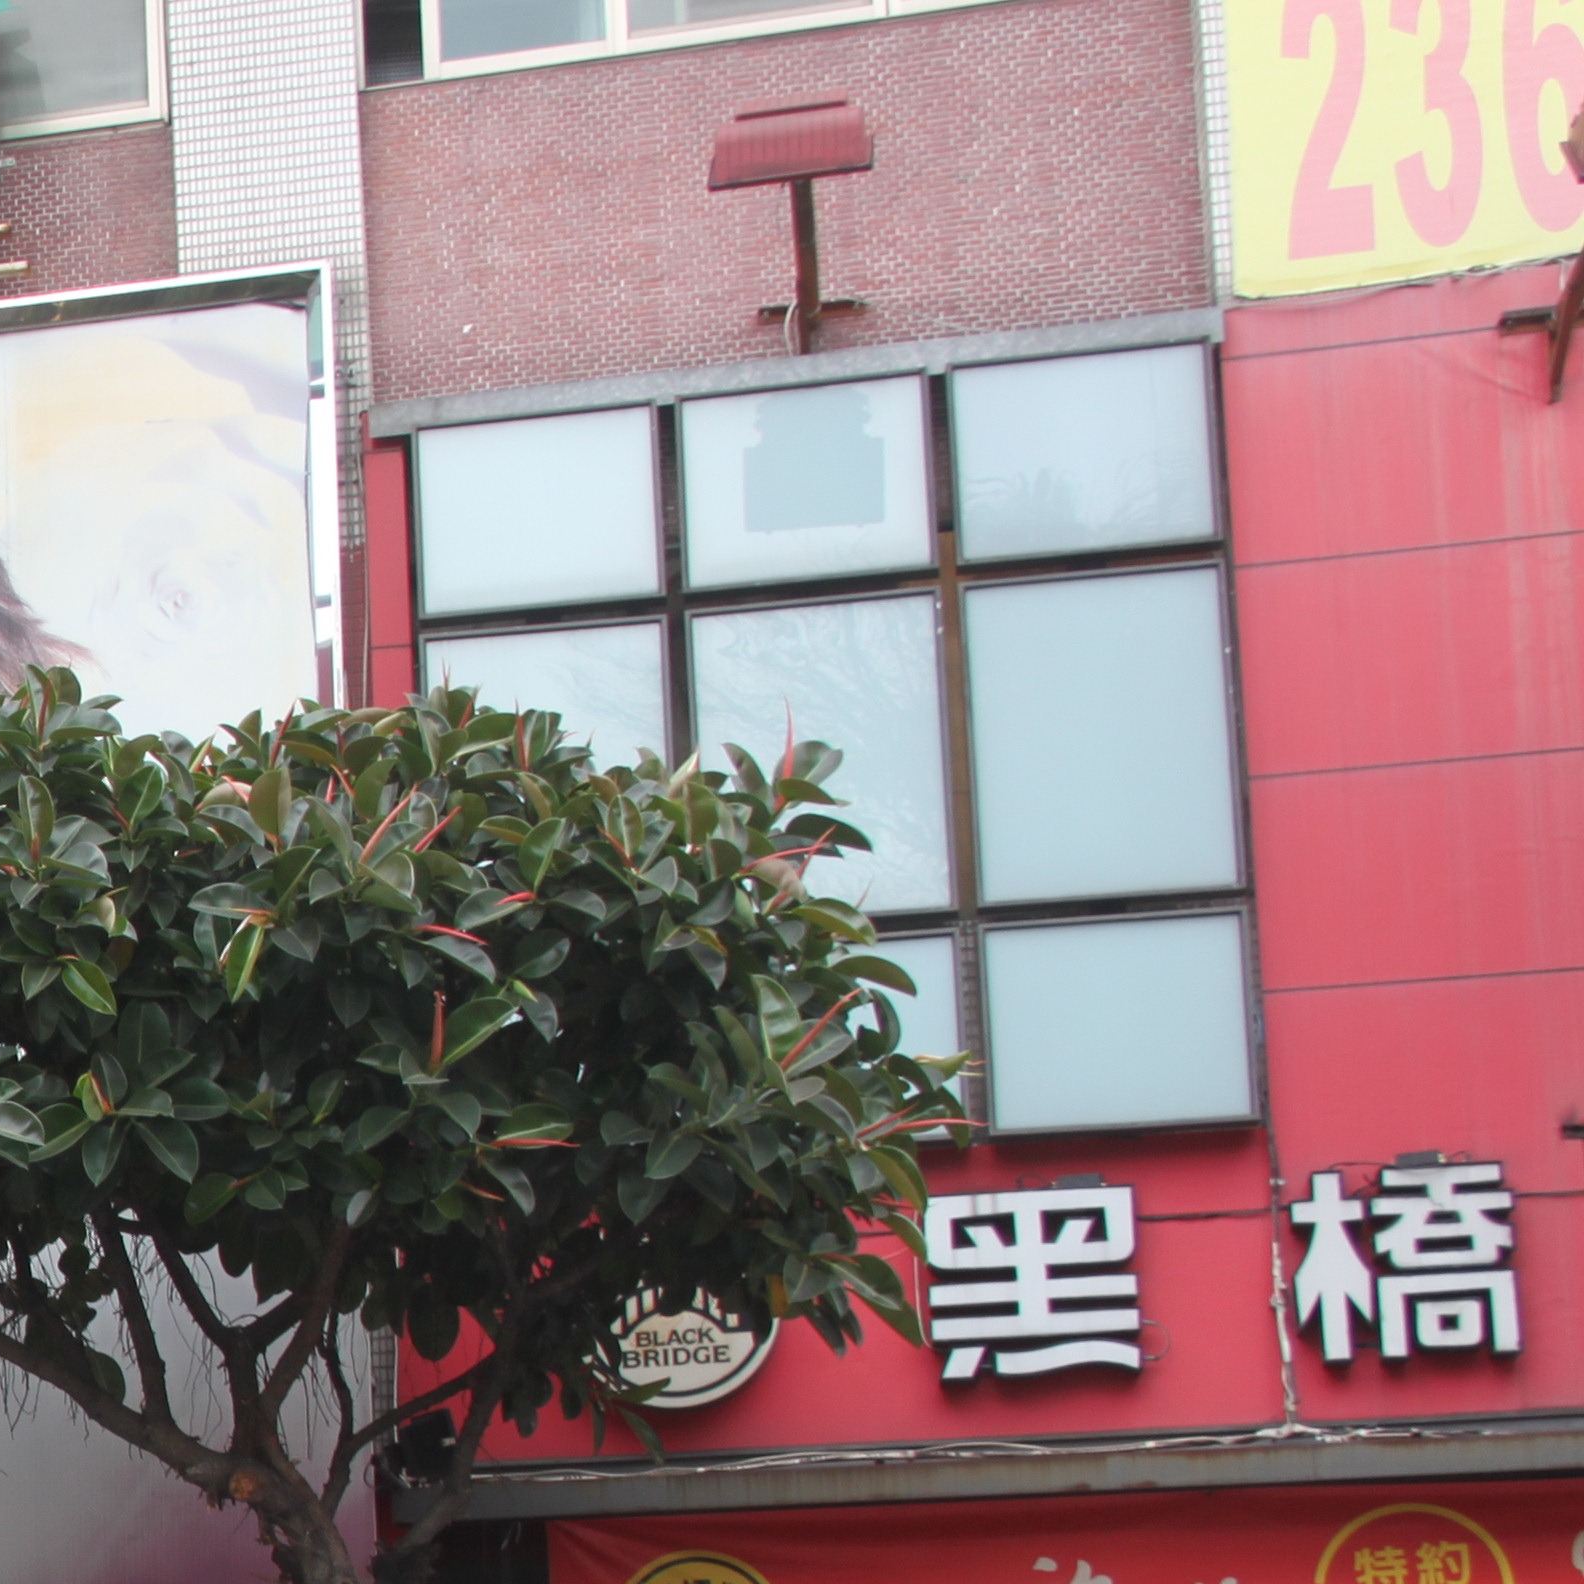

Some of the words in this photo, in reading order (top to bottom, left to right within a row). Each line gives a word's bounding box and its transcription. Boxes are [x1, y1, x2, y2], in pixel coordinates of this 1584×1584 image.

[922, 1160, 1522, 1386] 黑橋
[635, 1328, 715, 1347] BLACK
[623, 1345, 731, 1369] BRIDGE
